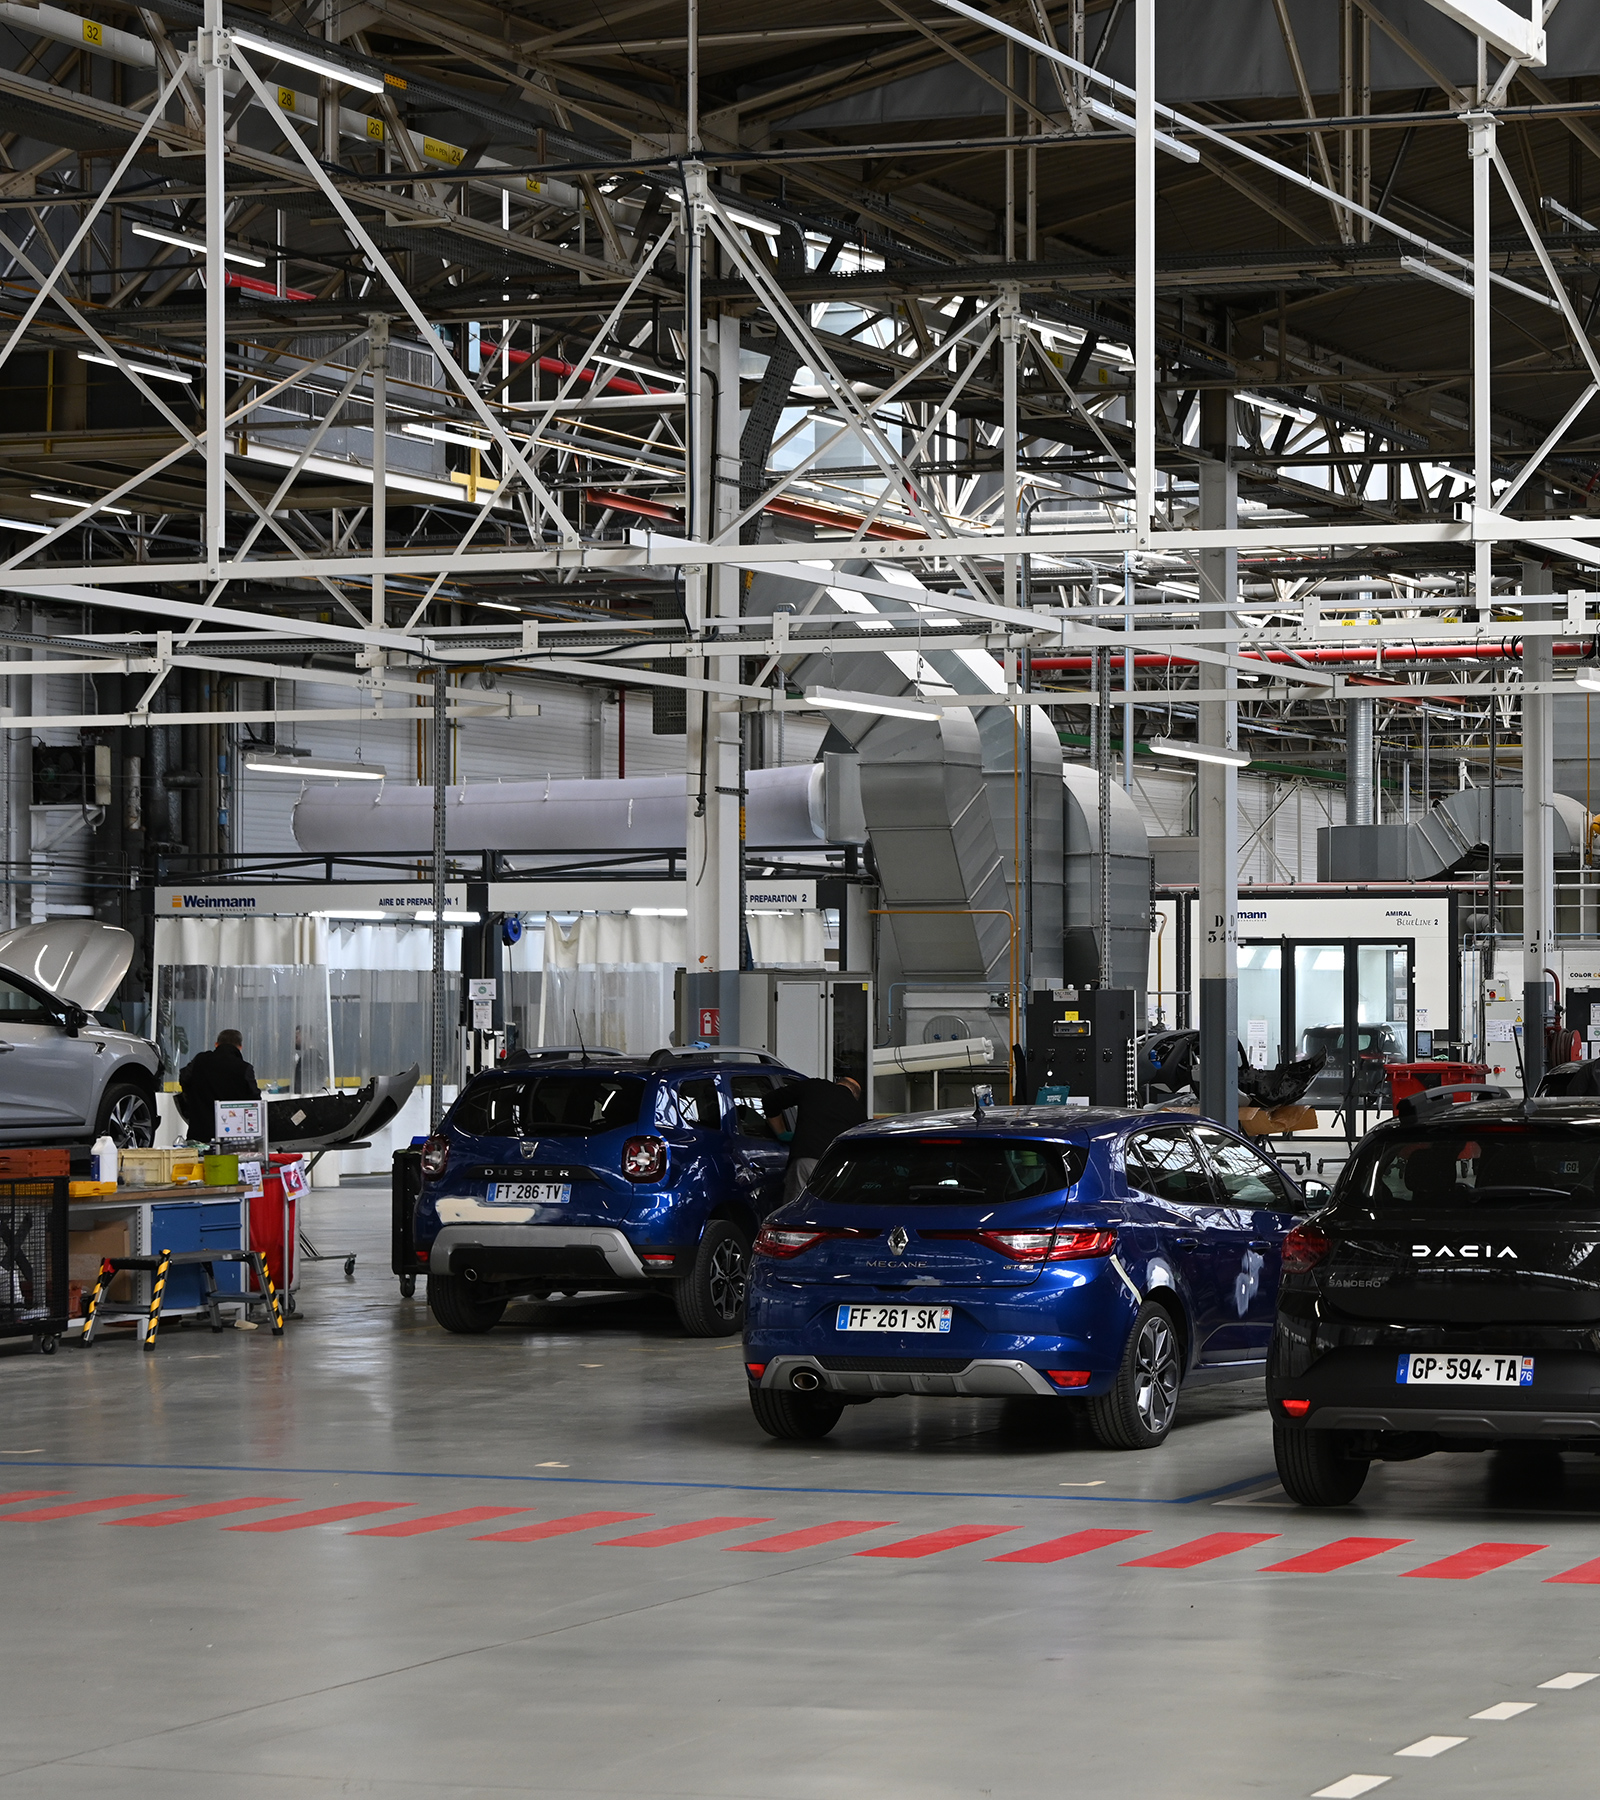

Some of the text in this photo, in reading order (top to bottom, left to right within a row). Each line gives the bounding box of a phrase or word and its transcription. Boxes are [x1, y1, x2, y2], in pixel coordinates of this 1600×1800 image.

[86, 24, 99, 40] 32
[281, 90, 292, 107] 28
[370, 122, 380, 136] 26
[183, 894, 256, 908] Weinmann
[379, 898, 394, 906] AIRE
[396, 898, 405, 906] DE
[750, 894, 798, 903] PREPARATION
[802, 894, 807, 903] 2
[1434, 918, 1439, 926] 2
[484, 1168, 570, 1177] DUSTER
[496, 1184, 562, 1200] FT-286-TV
[1412, 1244, 1518, 1259] DACIA
[1328, 1278, 1382, 1289] SANDERO
[850, 1308, 949, 1330] FF-261-SK 92
[1412, 1357, 1532, 1382] GP-594-TA 76
